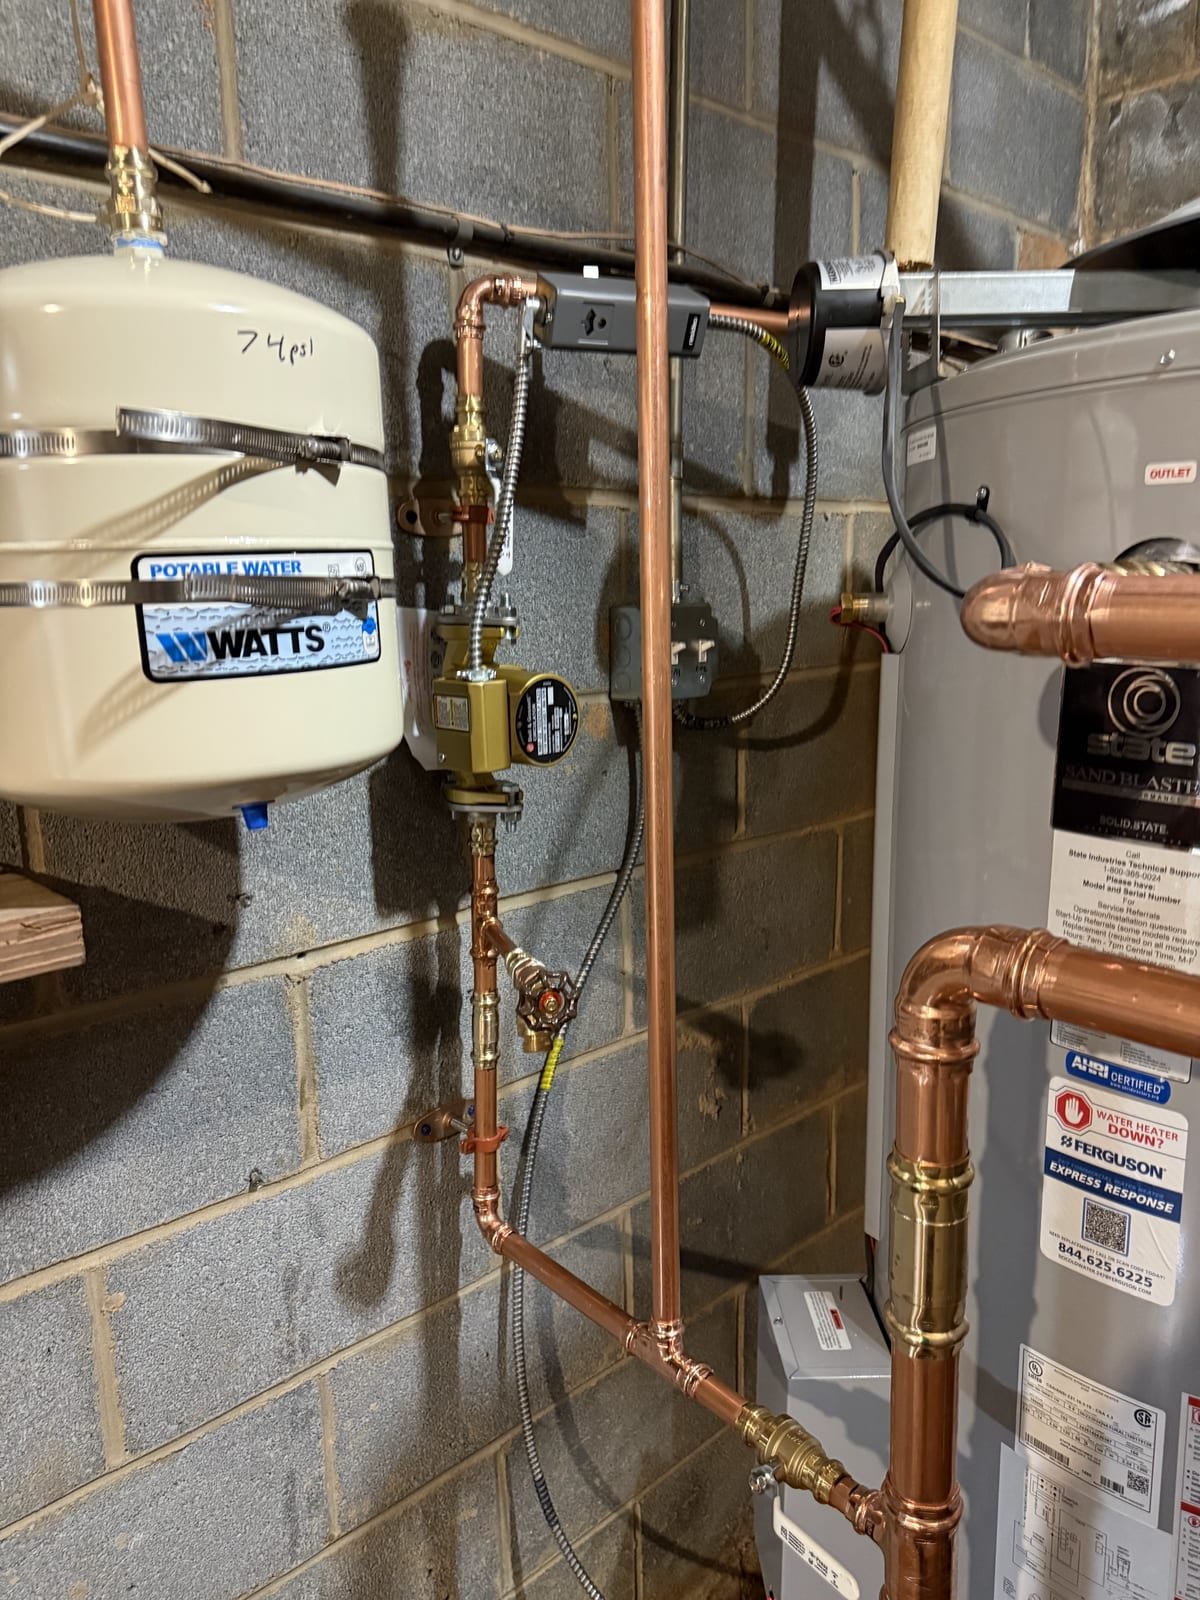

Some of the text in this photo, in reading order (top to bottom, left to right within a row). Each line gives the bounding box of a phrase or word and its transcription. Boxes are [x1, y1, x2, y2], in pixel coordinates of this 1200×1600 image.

[1150, 467, 1192, 481] OUTLET
[242, 560, 302, 576] WATER
[207, 625, 325, 660] WATTS
[1087, 732, 1197, 767] state
[1069, 849, 1087, 859] State
[1089, 853, 1127, 866] Industries
[1129, 860, 1168, 874] Technical
[1126, 850, 1141, 859] Call
[1082, 879, 1181, 905] Model and Serial Number
[1106, 874, 1155, 891] Please have:
[1097, 900, 1161, 920] Service Referrals
[1122, 897, 1135, 906] For
[1062, 920, 1107, 938] Replacement
[1108, 929, 1141, 945] (required
[1143, 938, 1153, 947] on
[1154, 940, 1164, 950] all
[1165, 943, 1198, 956] models)
[1084, 916, 1116, 930] Referrals
[1117, 922, 1140, 935] (some
[1142, 929, 1170, 941] models
[1150, 922, 1187, 935] questions
[1126, 944, 1153, 957] Central
[1155, 948, 1176, 962] Time,
[1071, 1055, 1109, 1079] AHRI
[1110, 1071, 1162, 1095] CERTIFIED
[1096, 1109, 1179, 1142] WATER HEATER
[1107, 1123, 1165, 1149] DOWN?
[1073, 1139, 1164, 1180] FERGUSON
[1050, 1161, 1175, 1214] EXPRESS RESPONSE
[1058, 1242, 1153, 1288] 844.625.6225
